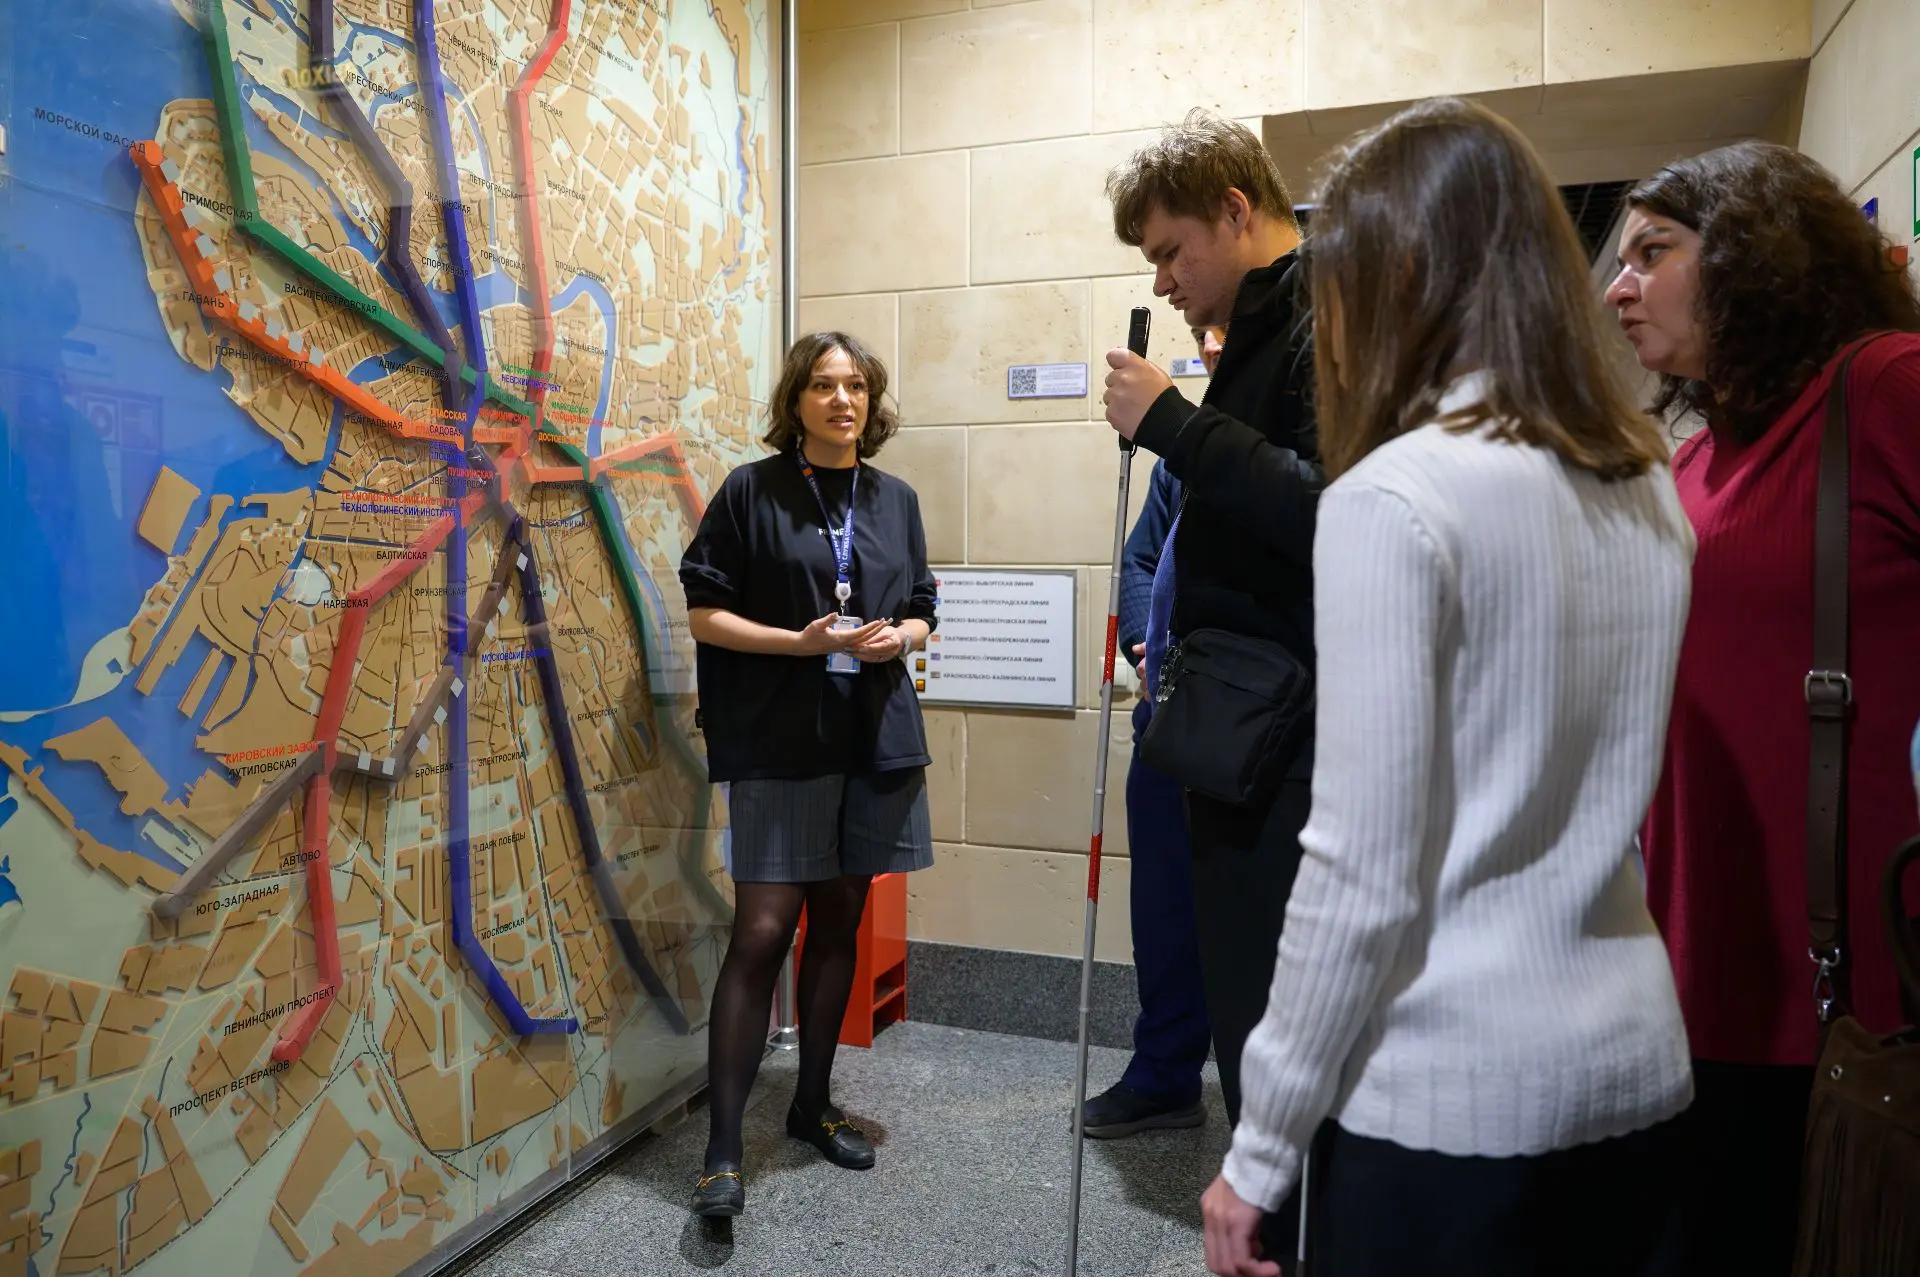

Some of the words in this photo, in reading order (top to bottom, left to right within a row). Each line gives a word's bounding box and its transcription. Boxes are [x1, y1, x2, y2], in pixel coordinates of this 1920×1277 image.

[346, 70, 404, 104] КРЕСТОВСКИЙ
[34, 107, 100, 140] МОРСКОЙ
[103, 131, 146, 154] ФАСАД
[181, 190, 253, 222] ПРИМОРСКАЯ
[182, 291, 225, 309] ГАВАНЬ
[284, 283, 377, 314] ВАСИЛЕОСТРОВСКАЯ
[215, 345, 258, 362] ГОРНЫЙ
[346, 413, 403, 431] ТЕАТРАЛЬНАЯ
[340, 502, 419, 516] ТЕХНОЛОГИЧЕСКИЙ
[420, 508, 457, 518] ИНСТИТУТ
[376, 550, 427, 561] БАЛТИЙСКАЯ
[323, 599, 369, 609] НАРВСКАЯ
[225, 747, 285, 765] КИРОВСКИЙ
[287, 741, 319, 755] ЗАВОД
[478, 752, 524, 767] ЭЛЕКТРОСИЛА
[229, 758, 297, 779] ПУТИЛОВСКАЯ
[415, 763, 454, 778] БРОНЕВАЯ
[479, 838, 497, 851] ПАРК
[282, 850, 321, 867] АВТОВО
[196, 884, 280, 916] ЮГО-ЗАПАДНАЯ
[481, 917, 525, 940] МОСКОВСКАЯ
[223, 1003, 285, 1037] ЛЕНИНСКИЙ
[287, 985, 336, 1013] ПРОСПЕКТ
[169, 1085, 228, 1118] ПРОСПЕКТ
[230, 1060, 290, 1092] ВЕТЕРАНОВ
